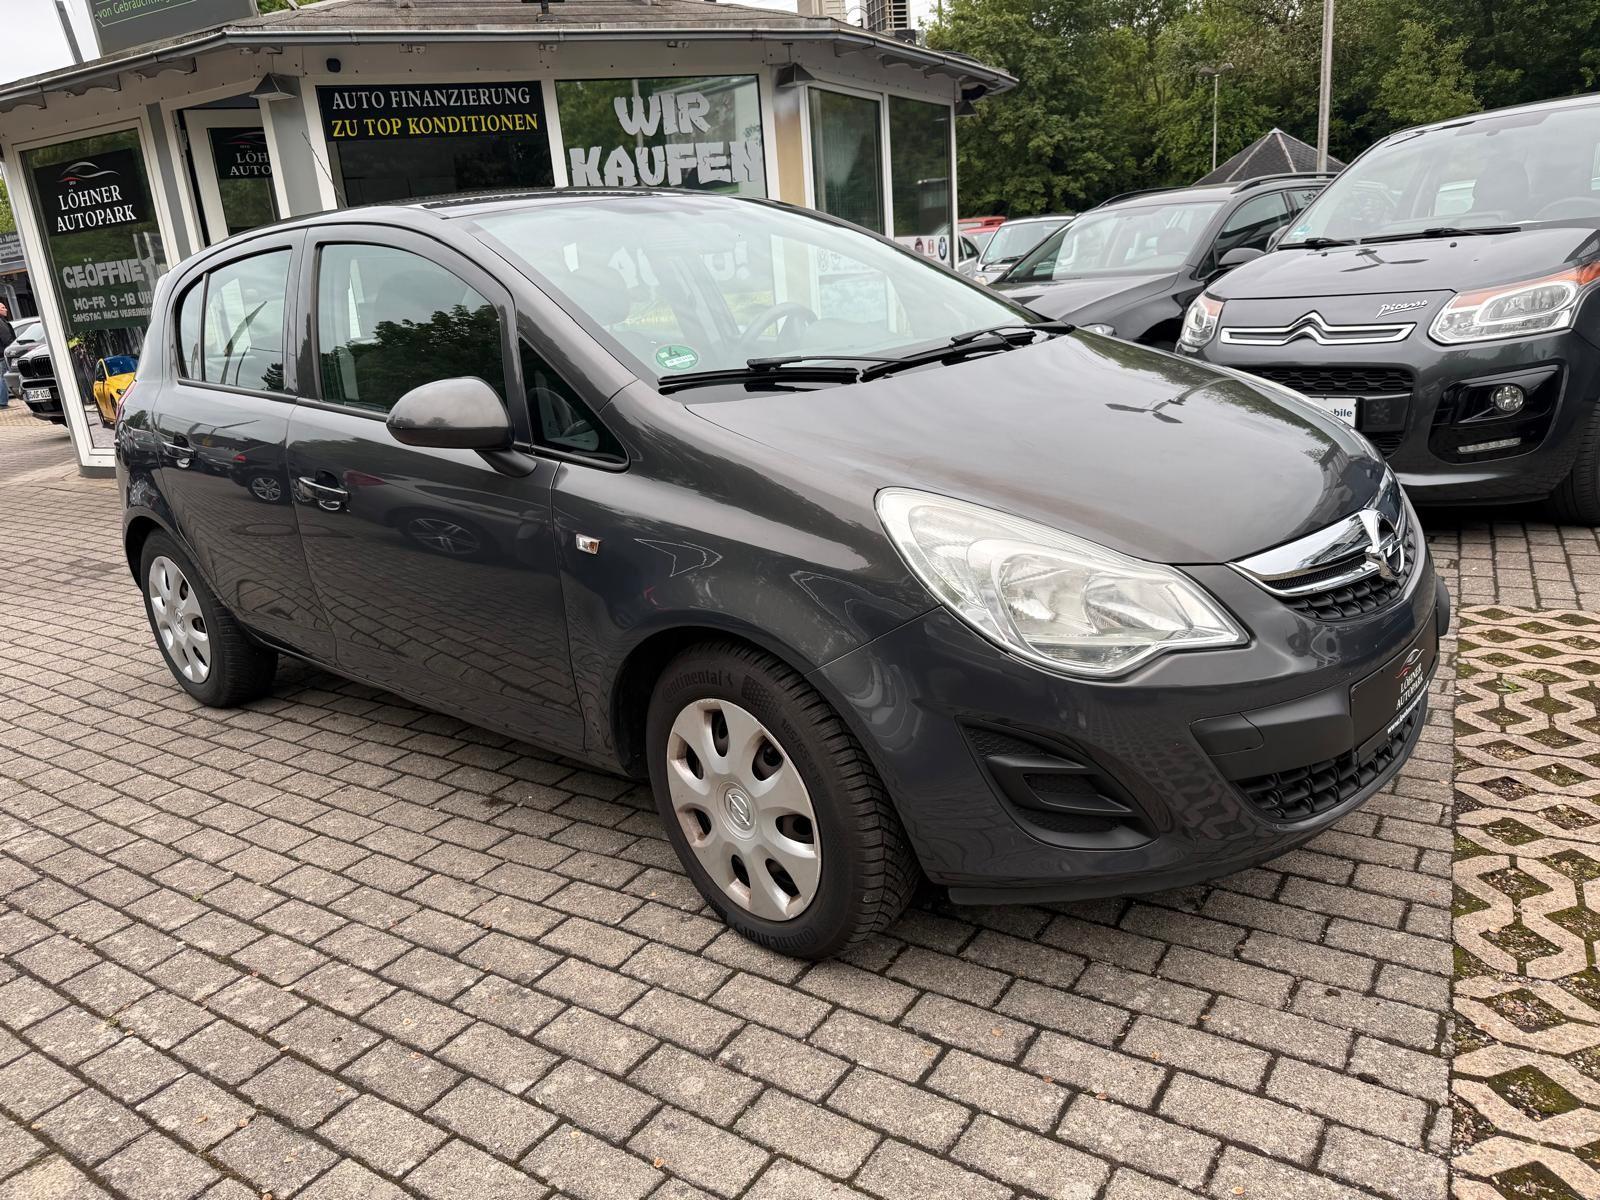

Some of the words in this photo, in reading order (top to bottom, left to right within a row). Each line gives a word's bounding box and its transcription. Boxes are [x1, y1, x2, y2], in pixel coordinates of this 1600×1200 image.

[332, 90, 385, 110] AUTO
[389, 87, 530, 108] FINANZIERUNG
[332, 118, 357, 137] ZU
[364, 117, 402, 136] TOP
[407, 113, 538, 135] KONDITIONEN
[613, 92, 712, 137] WIR
[569, 141, 763, 187] KAUFEN
[58, 184, 123, 211] LÖHNER
[57, 204, 137, 232] AUTOPARK
[62, 256, 156, 289] GEÖFFNET
[73, 295, 106, 311] MO-FR
[110, 294, 118, 307] 9
